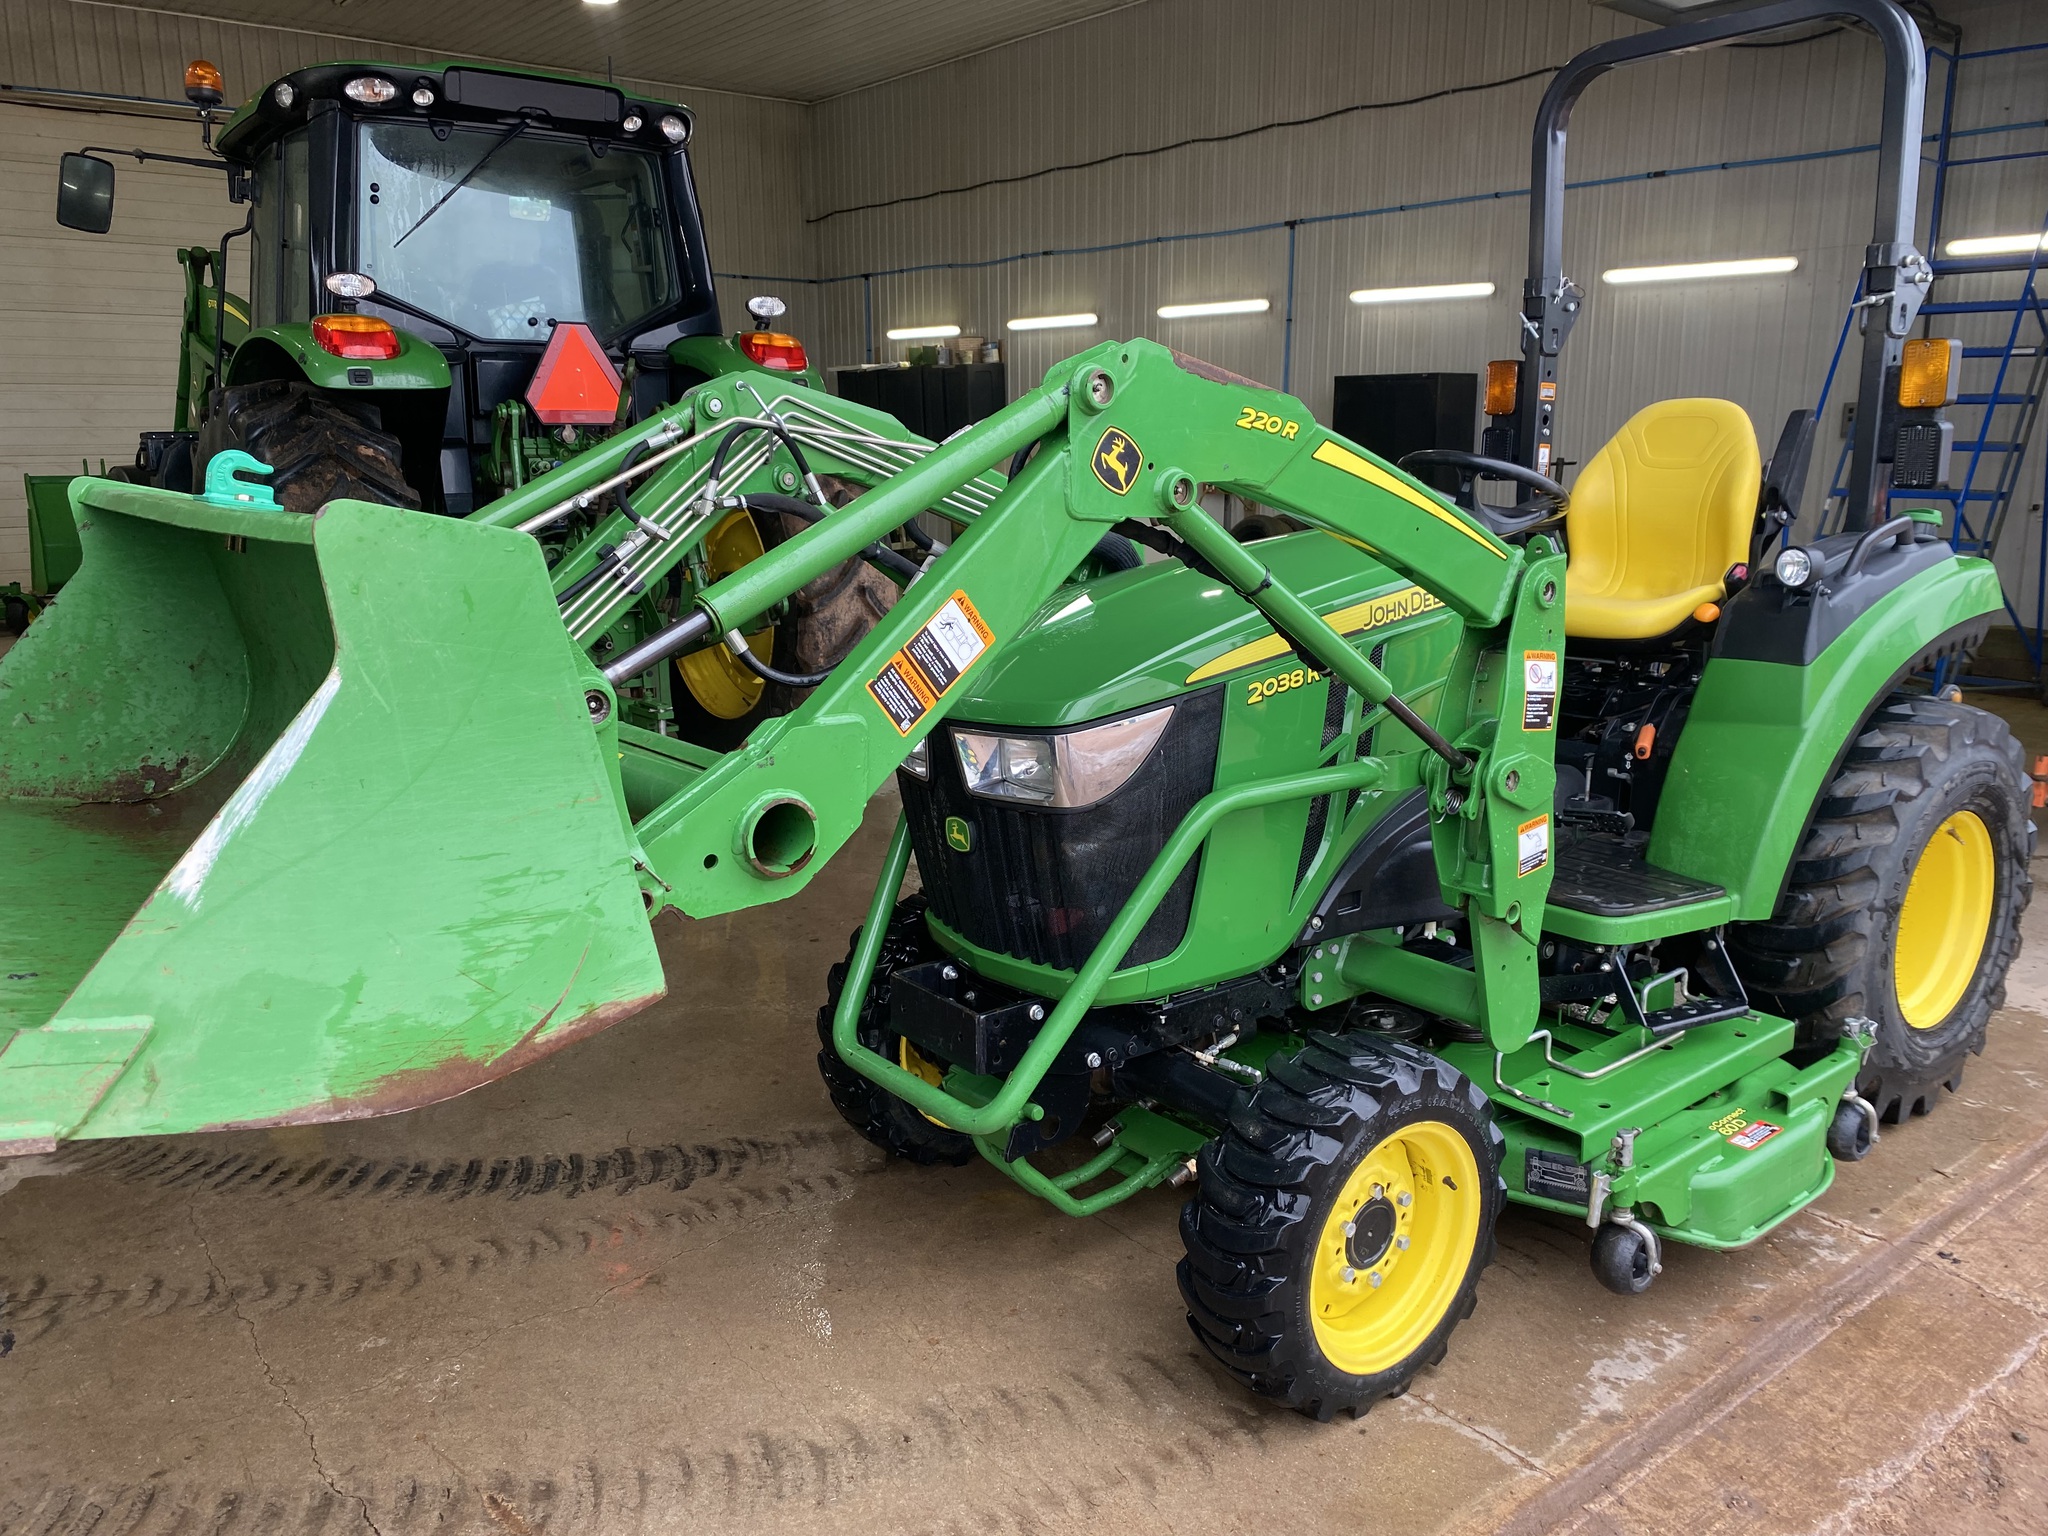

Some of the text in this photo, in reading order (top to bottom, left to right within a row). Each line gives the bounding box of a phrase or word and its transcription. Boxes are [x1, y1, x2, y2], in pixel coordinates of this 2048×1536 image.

[963, 603, 989, 639] WARNING
[1363, 598, 1408, 628] JOHN
[1530, 652, 1556, 661] WARNING
[903, 668, 930, 704] WARNING
[1718, 1118, 1748, 1136] 60D
